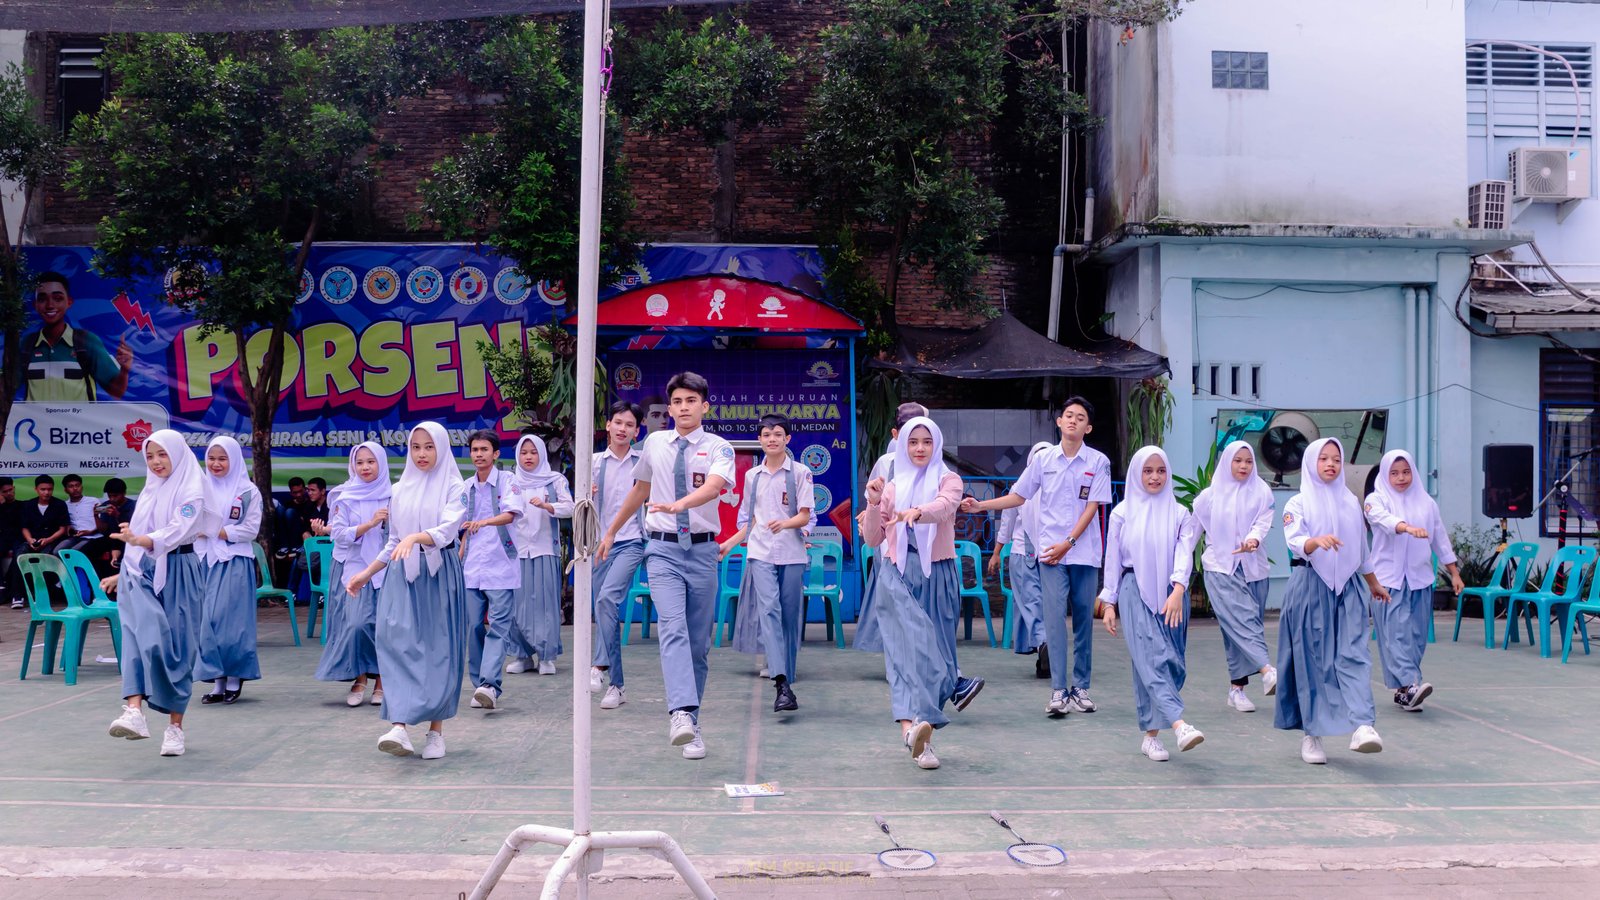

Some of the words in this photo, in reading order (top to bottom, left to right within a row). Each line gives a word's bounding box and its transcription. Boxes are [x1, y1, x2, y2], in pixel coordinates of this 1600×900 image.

[709, 394, 748, 402] OLAH
[759, 394, 838, 402] KEJURUAN
[721, 404, 773, 420] MULTI
[778, 404, 841, 420] KARYA
[718, 424, 735, 432] NO.
[736, 424, 748, 433] 10,
[801, 423, 835, 432] MEDAN
[49, 427, 112, 445] Biznet
[327, 430, 365, 446] SENI
[366, 430, 381, 444] &
[831, 438, 847, 449] Aa
[27, 461, 69, 469] KOMPUTER
[79, 460, 130, 469] MEGAHTEX
